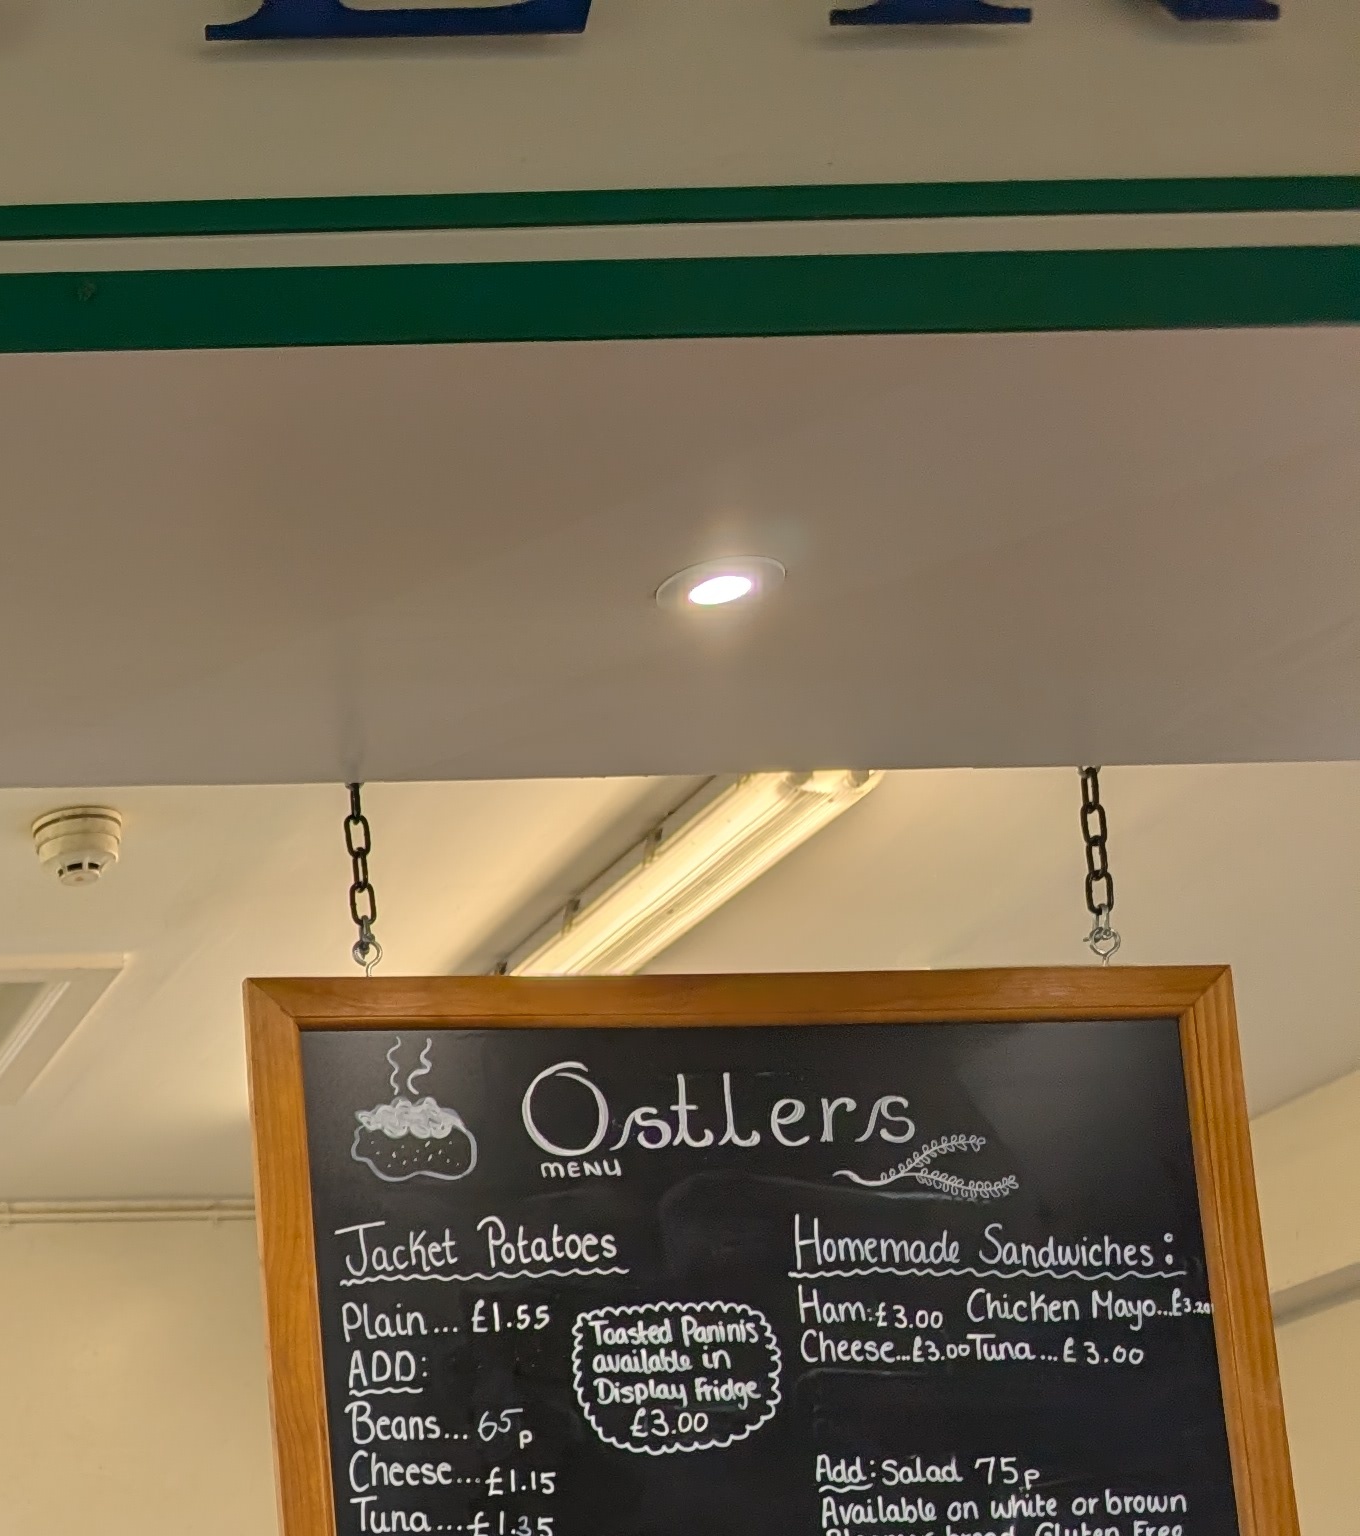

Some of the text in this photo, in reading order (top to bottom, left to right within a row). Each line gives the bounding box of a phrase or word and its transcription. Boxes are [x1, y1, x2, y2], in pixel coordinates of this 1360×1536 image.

[523, 1061, 915, 1156] Ostlers
[541, 1160, 621, 1177] MENU
[335, 1215, 617, 1276] Jacket Potatoes
[795, 1214, 959, 1269] Homemade
[472, 1299, 549, 1332] £1.55
[967, 1288, 1079, 1323] Chicken
[589, 1318, 759, 1345] Toasted Paninis
[593, 1345, 731, 1373] available in
[594, 1378, 761, 1412] Display Fridge
[631, 1409, 708, 1438] £3.00
[485, 1468, 555, 1496] £1.15
[882, 1456, 962, 1484] Salad
[975, 1457, 1040, 1489] 75p
[822, 1489, 1186, 1528] Available on white or brown
